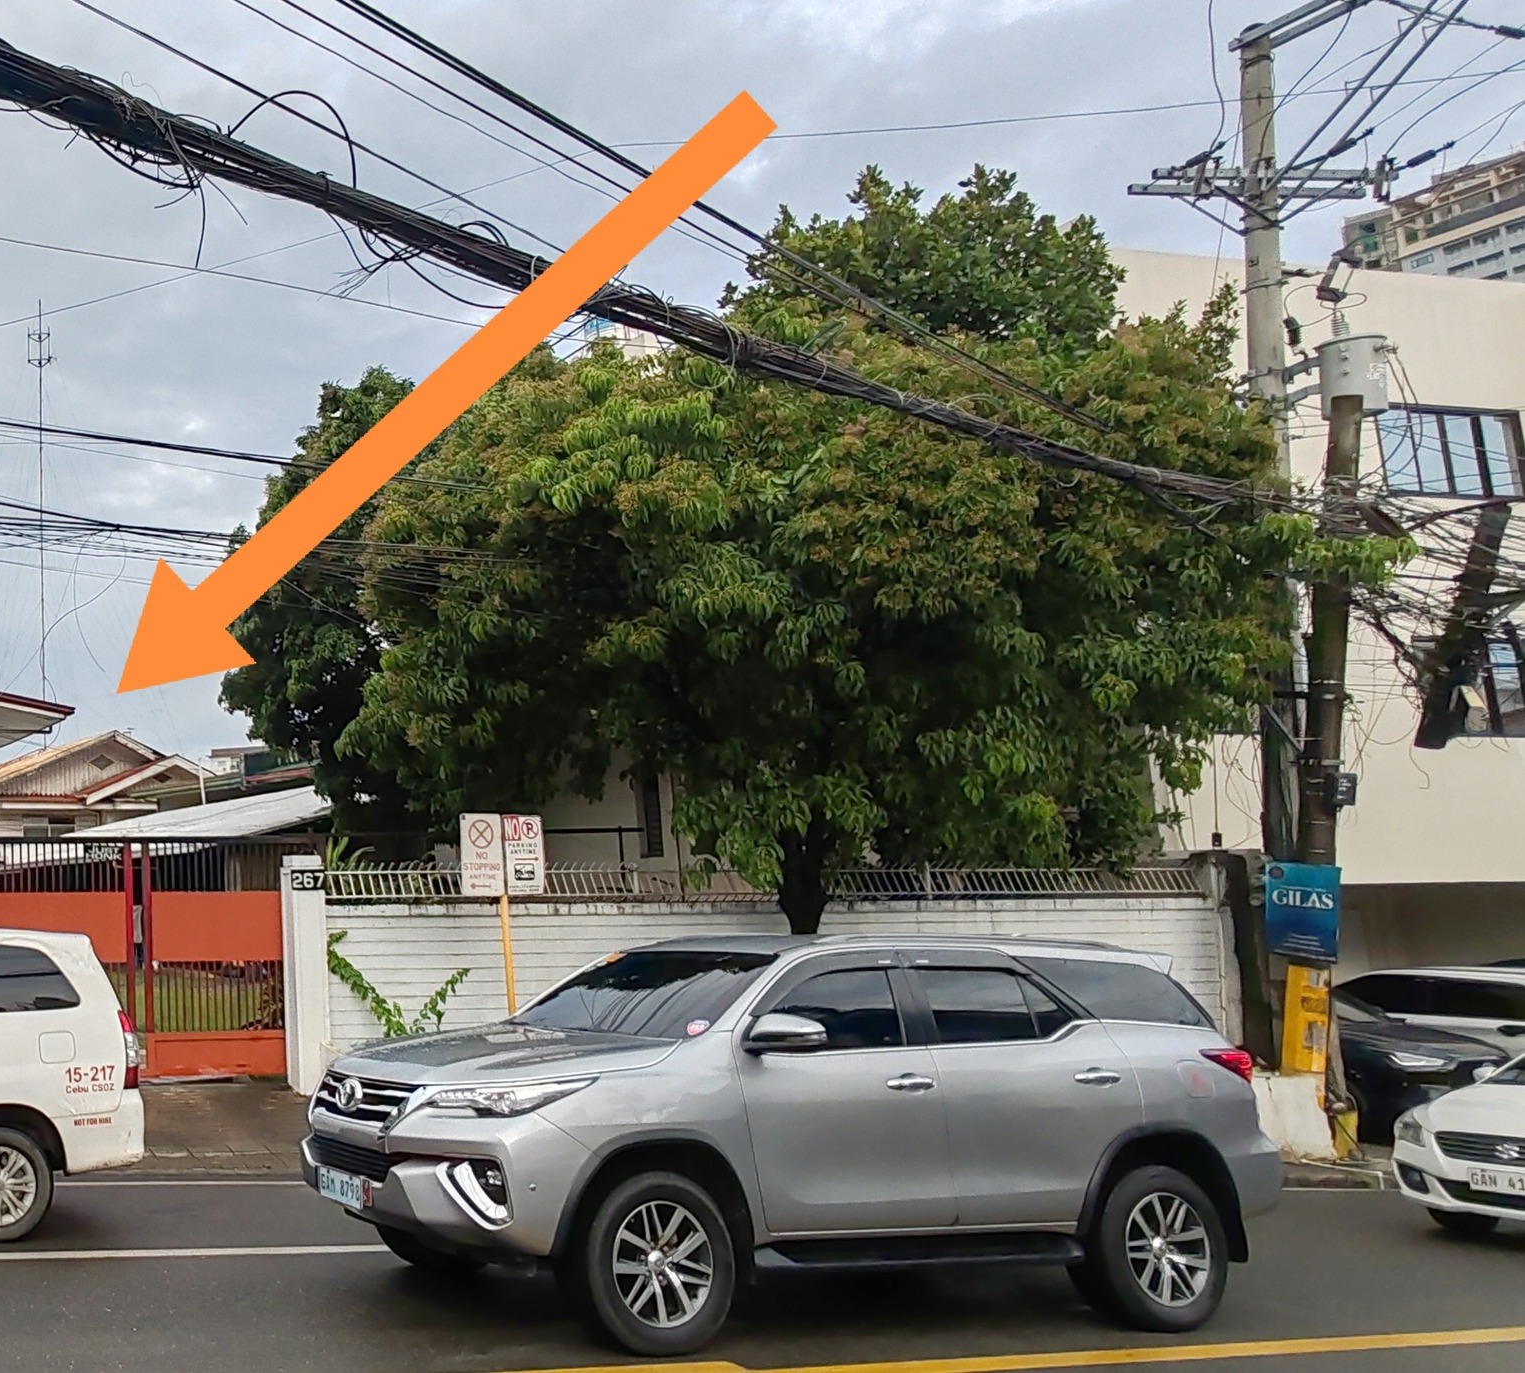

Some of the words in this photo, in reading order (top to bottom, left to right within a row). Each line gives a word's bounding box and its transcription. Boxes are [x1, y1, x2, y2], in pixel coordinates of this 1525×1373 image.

[503, 817, 520, 840] NO
[85, 852, 122, 861] HONK
[475, 851, 488, 860] NO
[463, 863, 501, 871] STOPPING
[292, 872, 325, 888] 267
[1272, 889, 1334, 910] GILAS
[65, 1065, 115, 1083] 15-217
[65, 1085, 89, 1094] Cebu
[74, 1118, 85, 1126] NOT
[86, 1117, 97, 1125] FOR
[98, 1116, 112, 1124] HIRE
[1471, 1172, 1497, 1187] GAN
[340, 1179, 360, 1201] 8798
